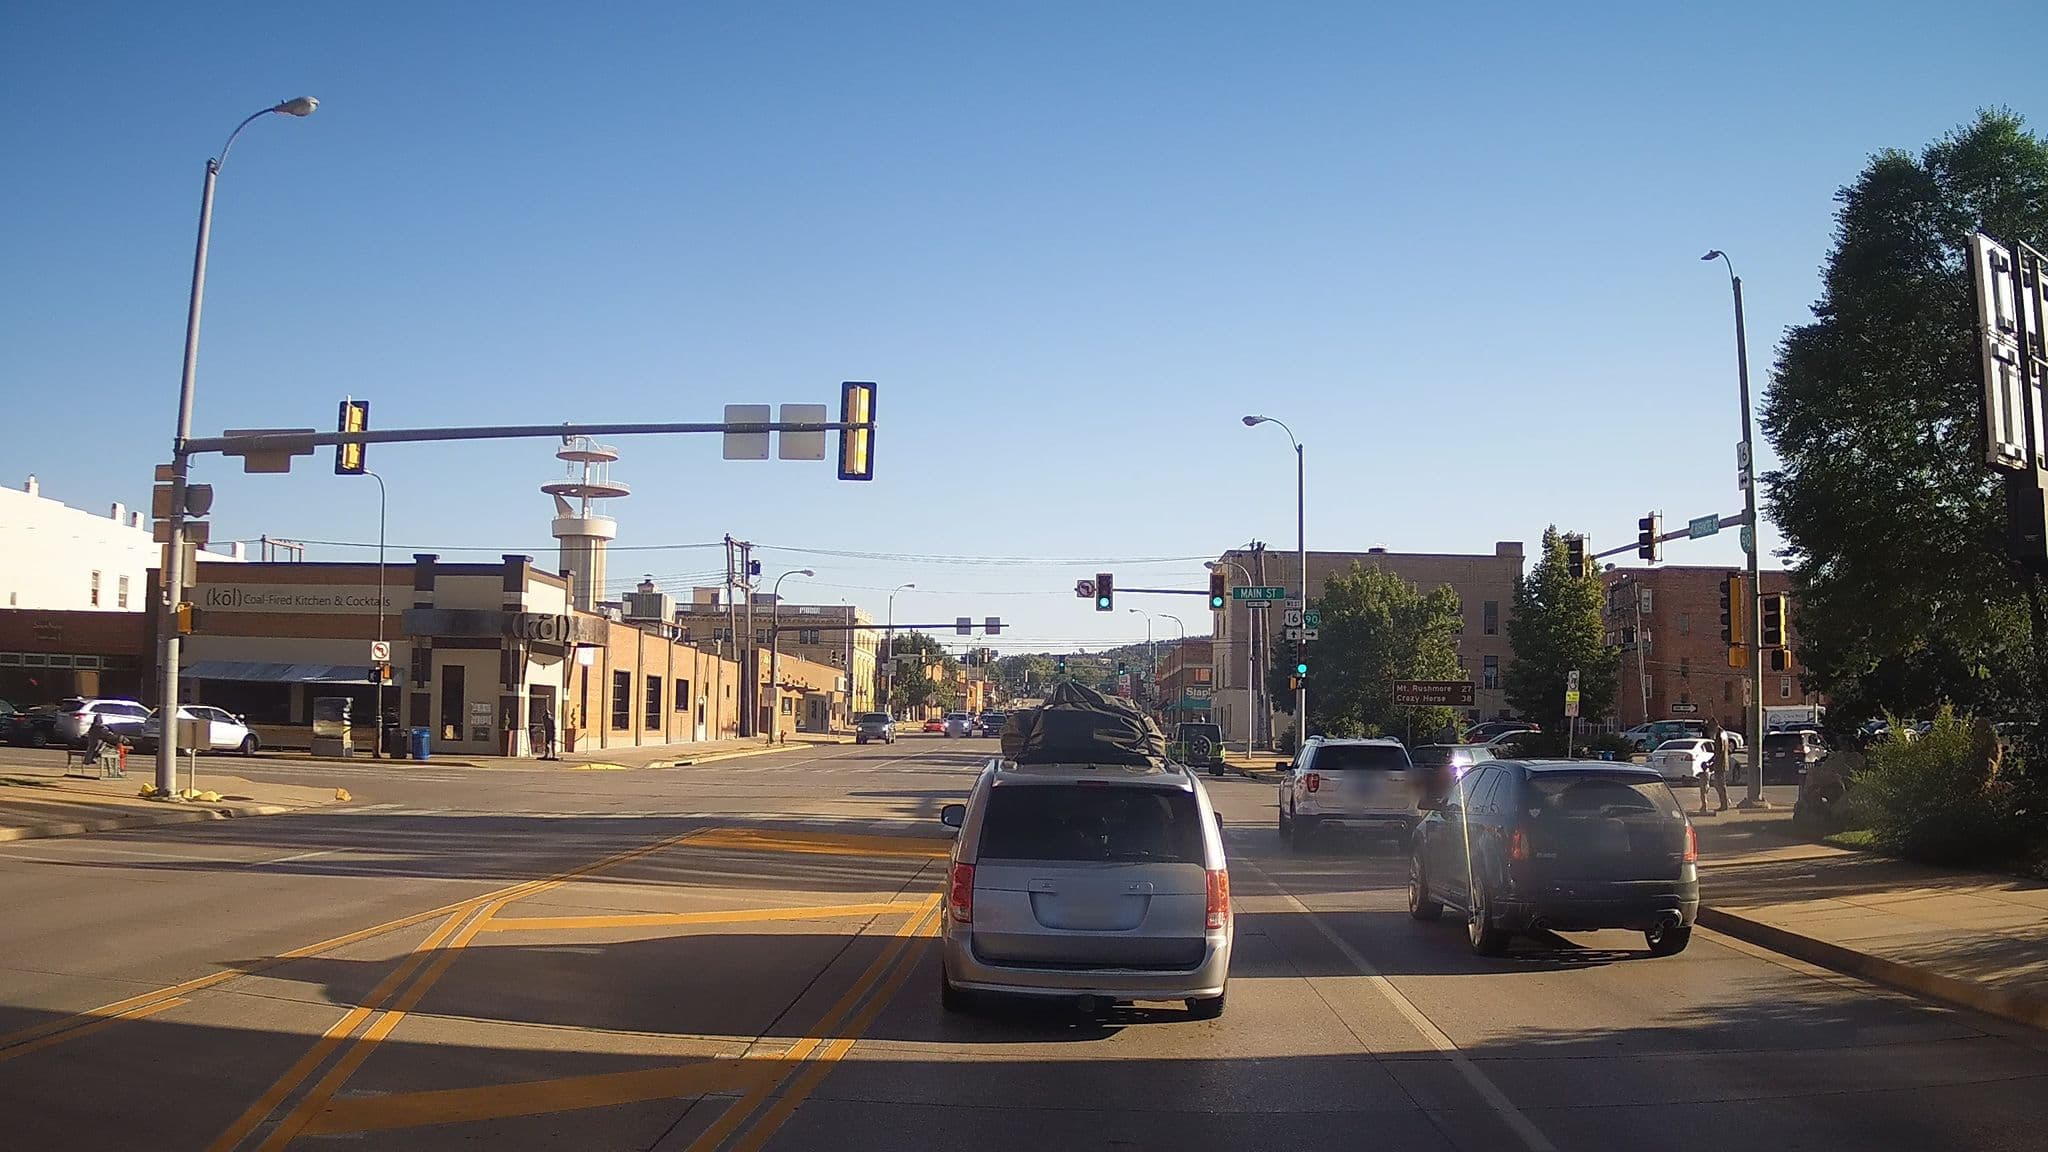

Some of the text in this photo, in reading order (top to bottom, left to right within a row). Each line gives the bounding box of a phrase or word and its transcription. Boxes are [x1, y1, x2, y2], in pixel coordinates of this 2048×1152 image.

[1240, 588, 1277, 598] MAIN ST
[243, 593, 292, 605] Coal-Fired
[295, 595, 332, 606] Kitchen
[334, 596, 343, 606] &
[1287, 613, 1299, 621] 16
[1305, 616, 1318, 624] 90
[1396, 684, 1472, 693] Mt. Rushmore 27
[1396, 694, 1420, 703] Crazy
